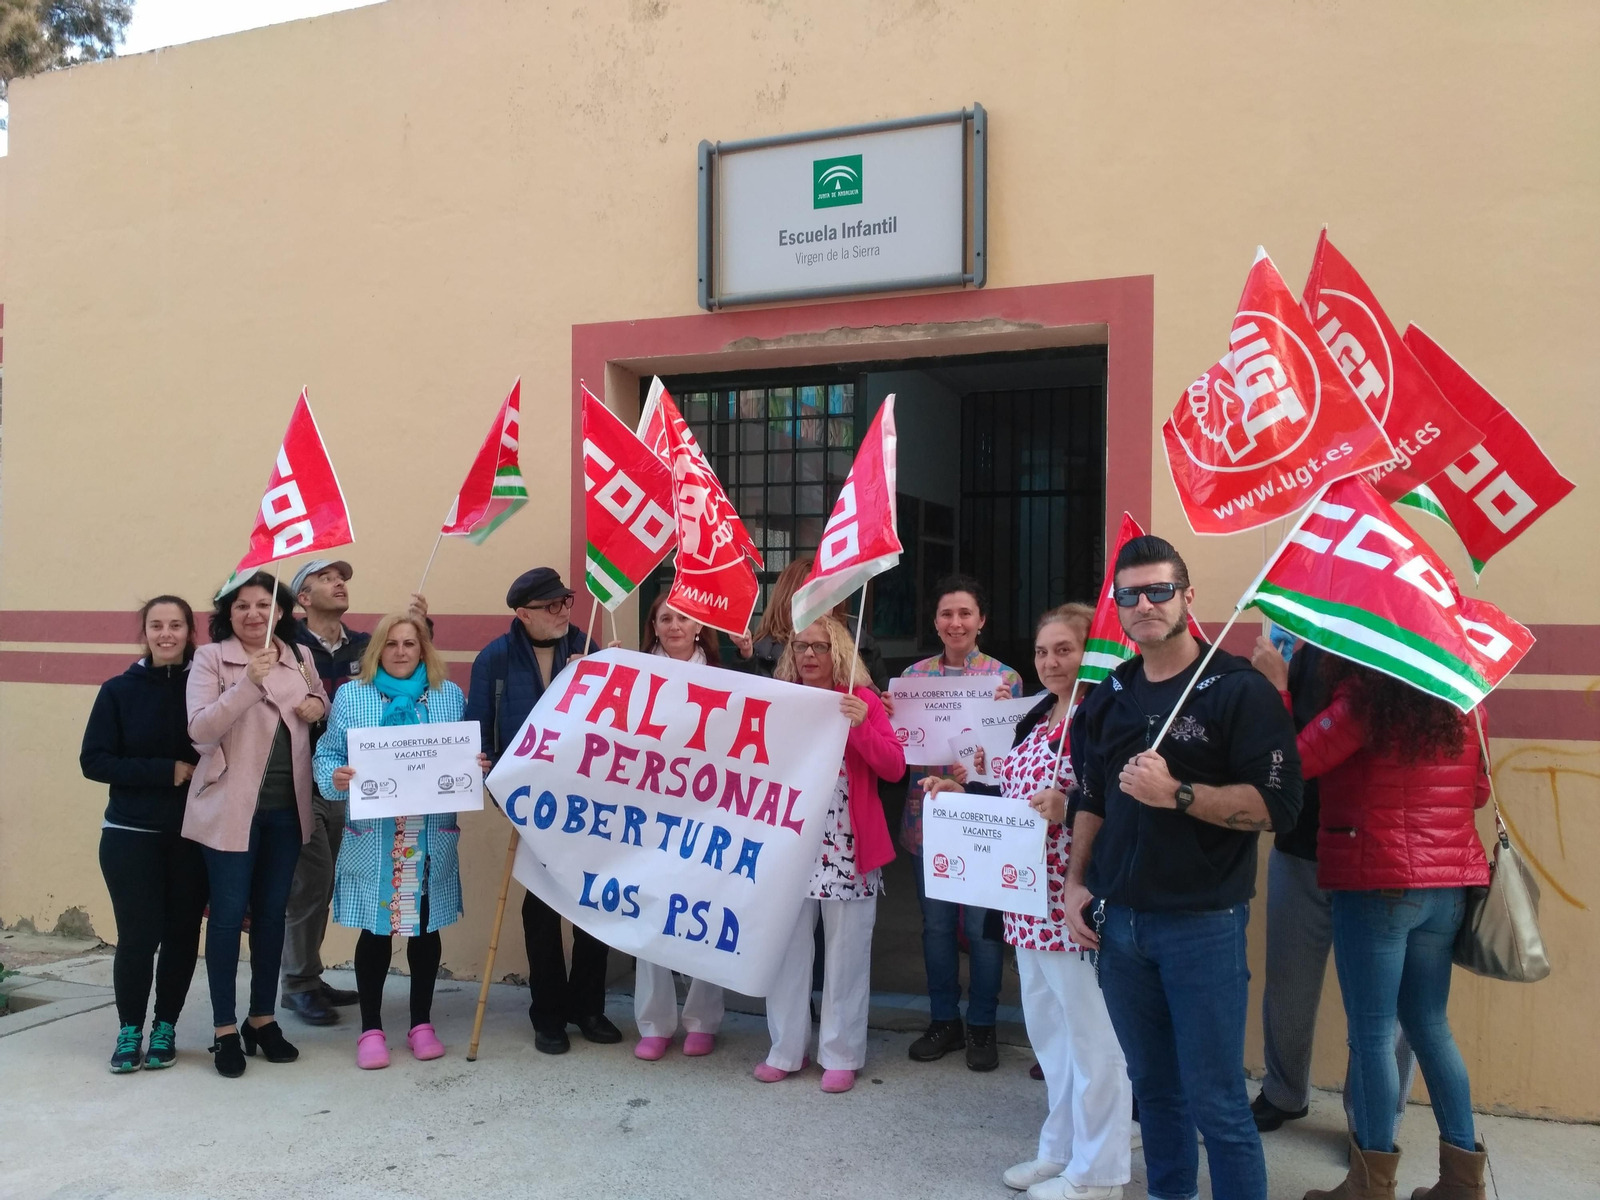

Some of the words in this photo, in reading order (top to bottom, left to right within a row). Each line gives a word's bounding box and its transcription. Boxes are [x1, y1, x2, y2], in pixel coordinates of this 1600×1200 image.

[817, 192, 830, 200] JUNTA
[779, 225, 837, 246] Escuela
[842, 216, 897, 239] Infantil
[795, 252, 824, 266] Virgen
[827, 248, 838, 262] de
[841, 247, 850, 259] la
[852, 245, 880, 259] Sierra
[1212, 441, 1354, 520] www.ugt.es
[922, 690, 964, 698] COBERTURA
[554, 660, 772, 766] FALTA
[981, 717, 996, 726] POR
[996, 716, 1007, 724] LA
[359, 742, 376, 750] POR
[378, 741, 389, 749] LA
[391, 737, 439, 748] COBERTURA
[454, 735, 471, 743] LAS
[958, 746, 975, 757] POR
[394, 749, 438, 759] VACANTES
[513, 723, 562, 763] DE
[576, 733, 806, 836] PERSONAL
[932, 808, 947, 817] POR
[948, 810, 959, 819] LA
[960, 811, 1004, 824] COBERTURA
[1005, 816, 1017, 825] DE
[1019, 818, 1036, 828] LAS
[505, 785, 765, 884] COBERTURA
[962, 825, 1003, 839] VACANTES
[578, 871, 641, 919] LOS
[661, 893, 741, 956] P.S.D.
